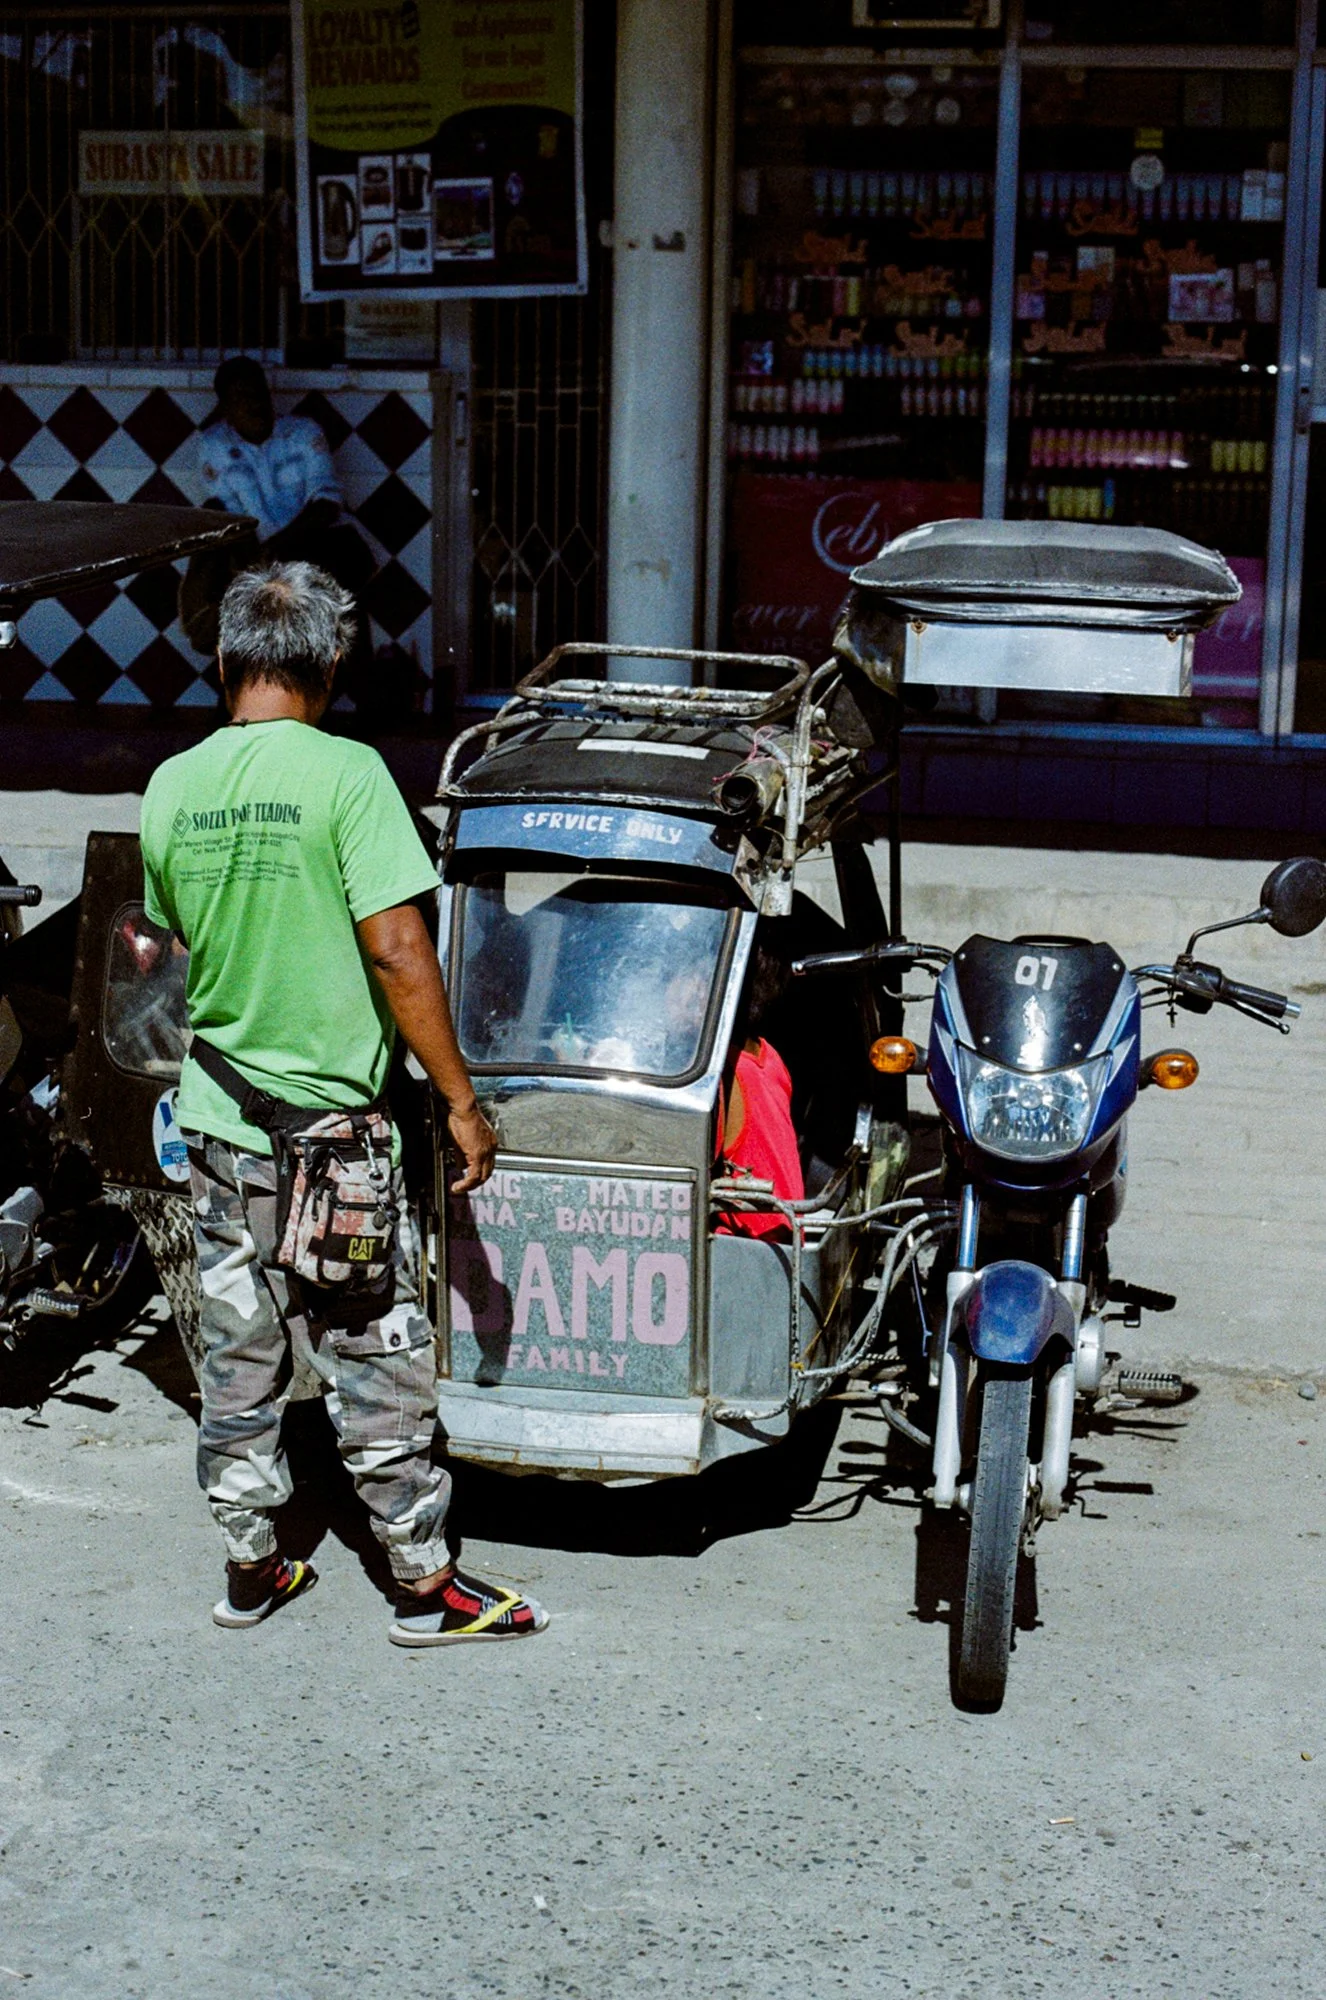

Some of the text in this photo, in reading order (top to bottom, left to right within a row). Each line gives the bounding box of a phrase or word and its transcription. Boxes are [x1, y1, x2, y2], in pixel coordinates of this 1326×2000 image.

[308, 8, 404, 47] LOYALTY
[311, 46, 420, 88] REWARDS
[86, 142, 259, 181] SUBASTA SALE
[626, 818, 683, 845] ONLY
[588, 1179, 692, 1210] MATEO
[555, 1205, 692, 1242] BAYUDAN
[348, 1237, 376, 1261] CAT
[505, 1343, 629, 1379] FAMILY
